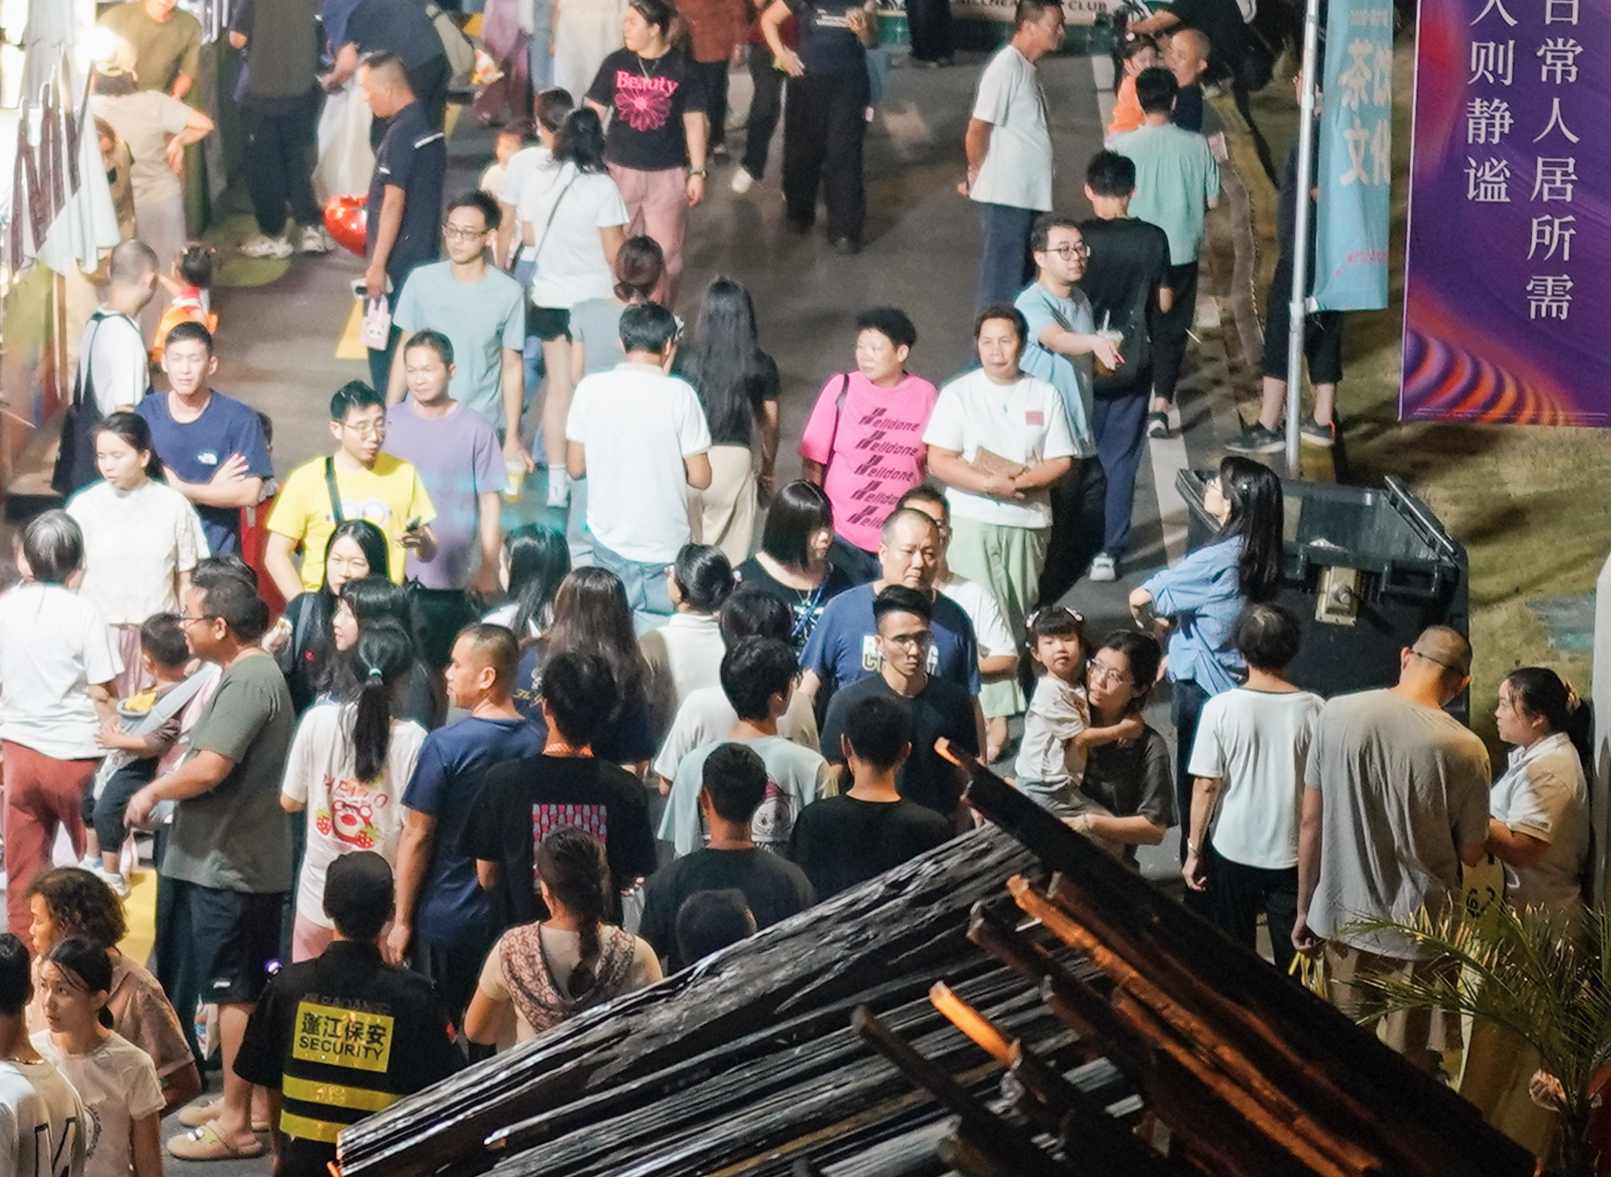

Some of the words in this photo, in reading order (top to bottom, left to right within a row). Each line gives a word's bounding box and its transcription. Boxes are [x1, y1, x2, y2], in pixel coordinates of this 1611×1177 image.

[616, 70, 679, 98] Beauty
[302, 1011, 387, 1047] 蓬江保安
[299, 1036, 385, 1062] SECURITY
